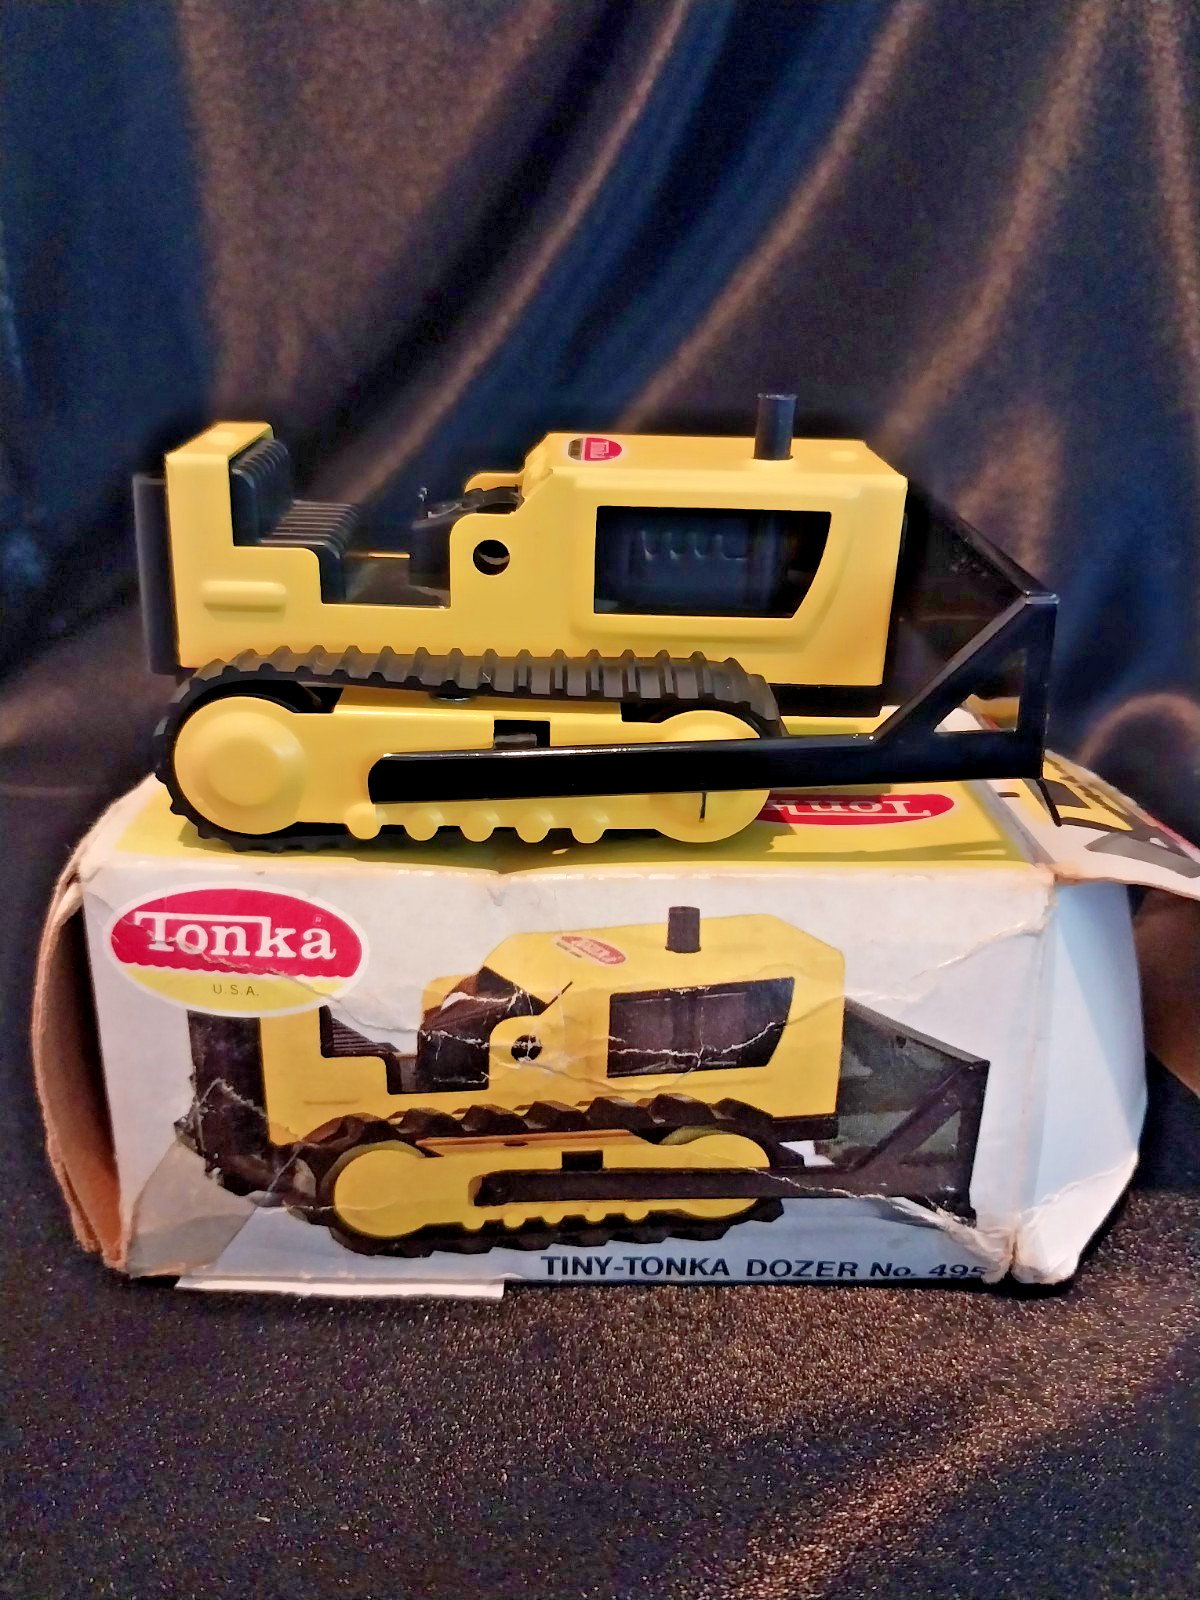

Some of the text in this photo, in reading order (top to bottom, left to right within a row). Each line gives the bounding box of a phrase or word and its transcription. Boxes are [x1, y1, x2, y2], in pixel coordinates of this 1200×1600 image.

[134, 910, 337, 960] Tonka
[213, 983, 260, 996] U.S.A.
[540, 1255, 730, 1276] TINY-TONKA
[746, 1258, 859, 1277] DOZER
[870, 1262, 916, 1278] No.
